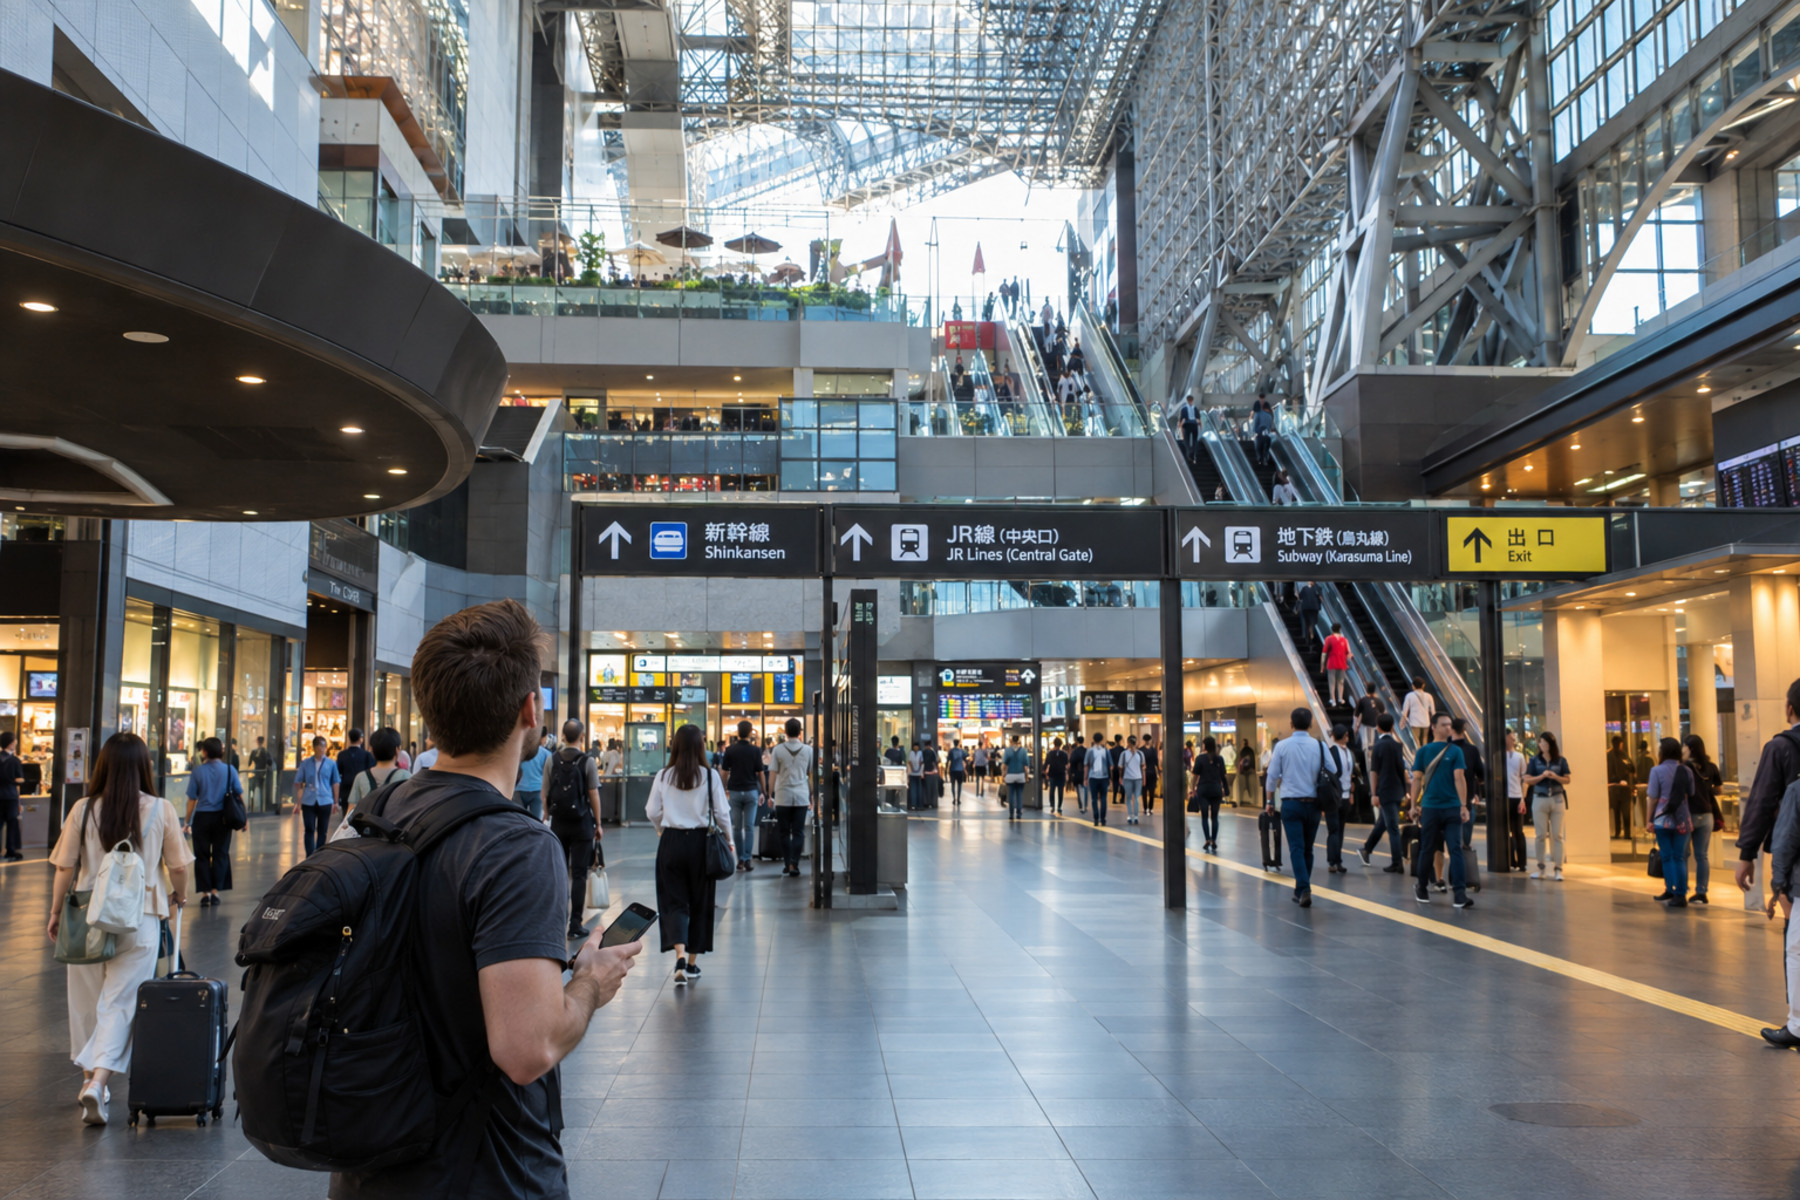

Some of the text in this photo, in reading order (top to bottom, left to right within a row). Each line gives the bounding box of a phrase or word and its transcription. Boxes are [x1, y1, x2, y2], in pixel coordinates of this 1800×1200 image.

[705, 522, 770, 543] 新幹線
[1508, 528, 1554, 546] 出口
[705, 545, 785, 560] Shinkansen
[947, 548, 1093, 563] JR Lines (Central Gate)
[1277, 550, 1412, 565] Subway (Karasuma Line)
[1508, 550, 1532, 562] Exit
